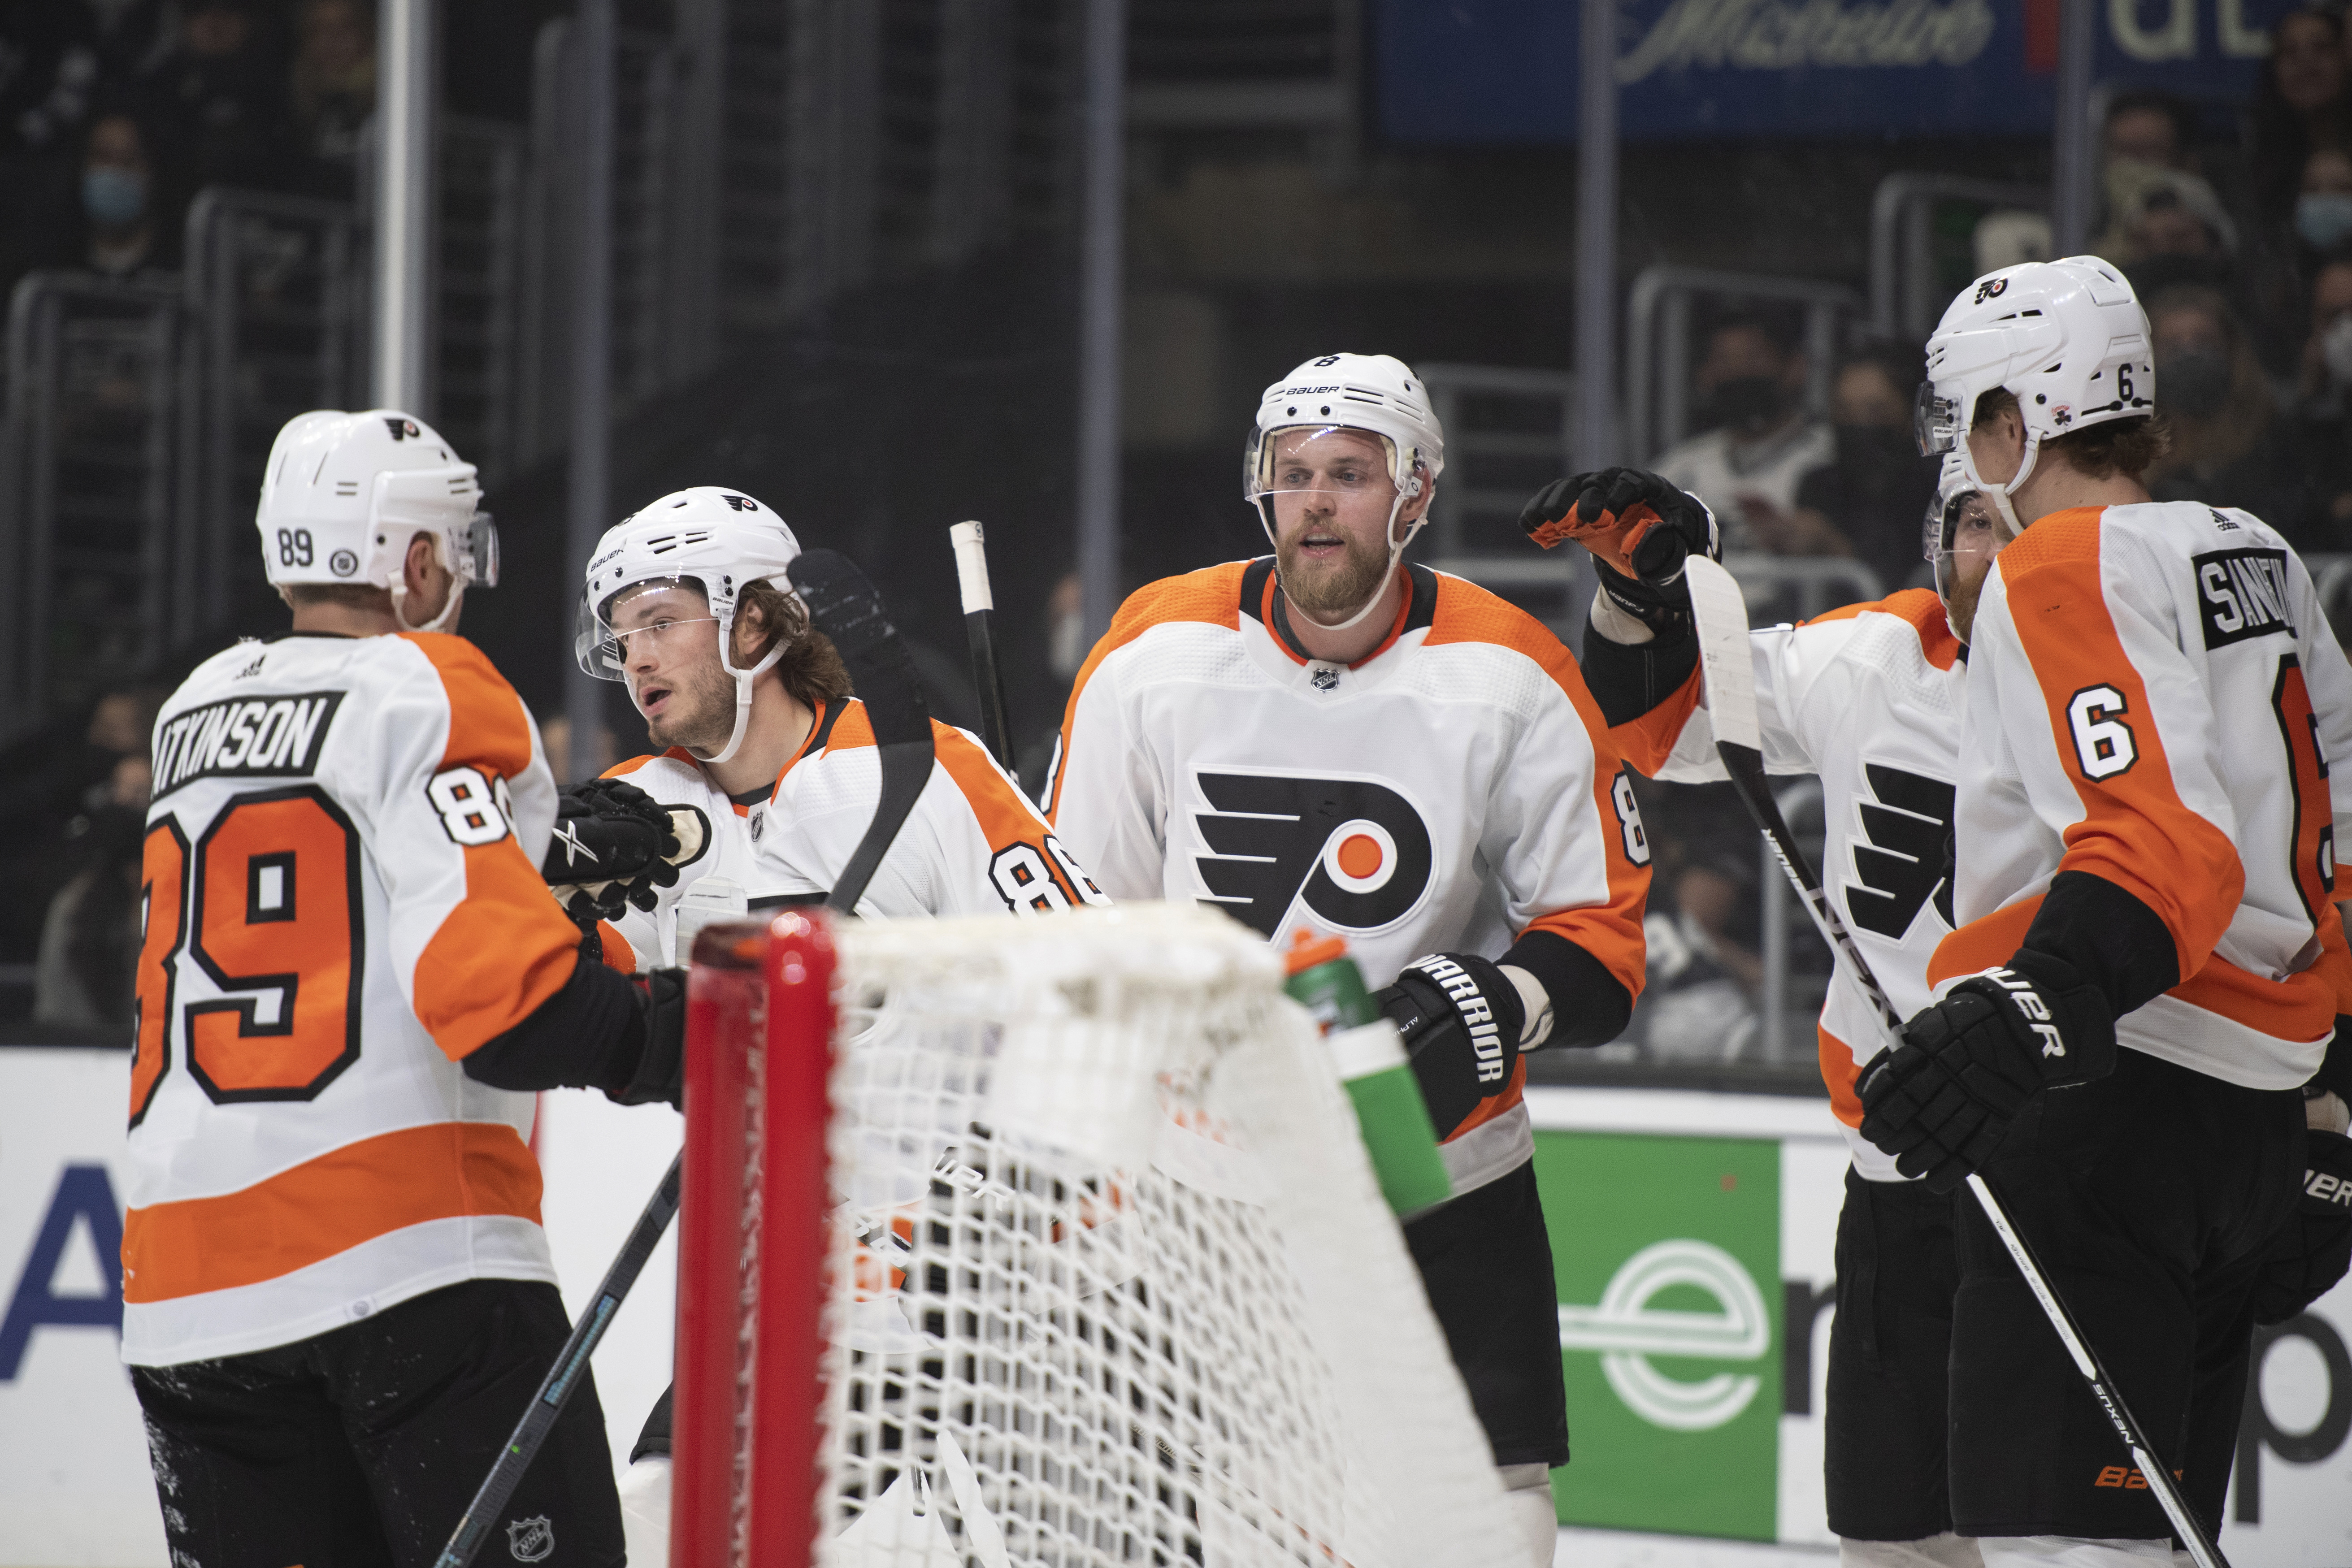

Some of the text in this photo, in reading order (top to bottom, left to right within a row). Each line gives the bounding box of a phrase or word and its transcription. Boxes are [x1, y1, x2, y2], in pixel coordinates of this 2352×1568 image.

[1314, 356, 1341, 367] 8
[1286, 386, 1340, 395] BAUER
[2118, 363, 2133, 401] 6
[278, 527, 314, 567] 89
[712, 597, 733, 606] BAUER
[2066, 682, 2139, 784] 6
[1400, 953, 1503, 1083] WARRIOR
[2092, 1384, 2135, 1443] NEXUS
